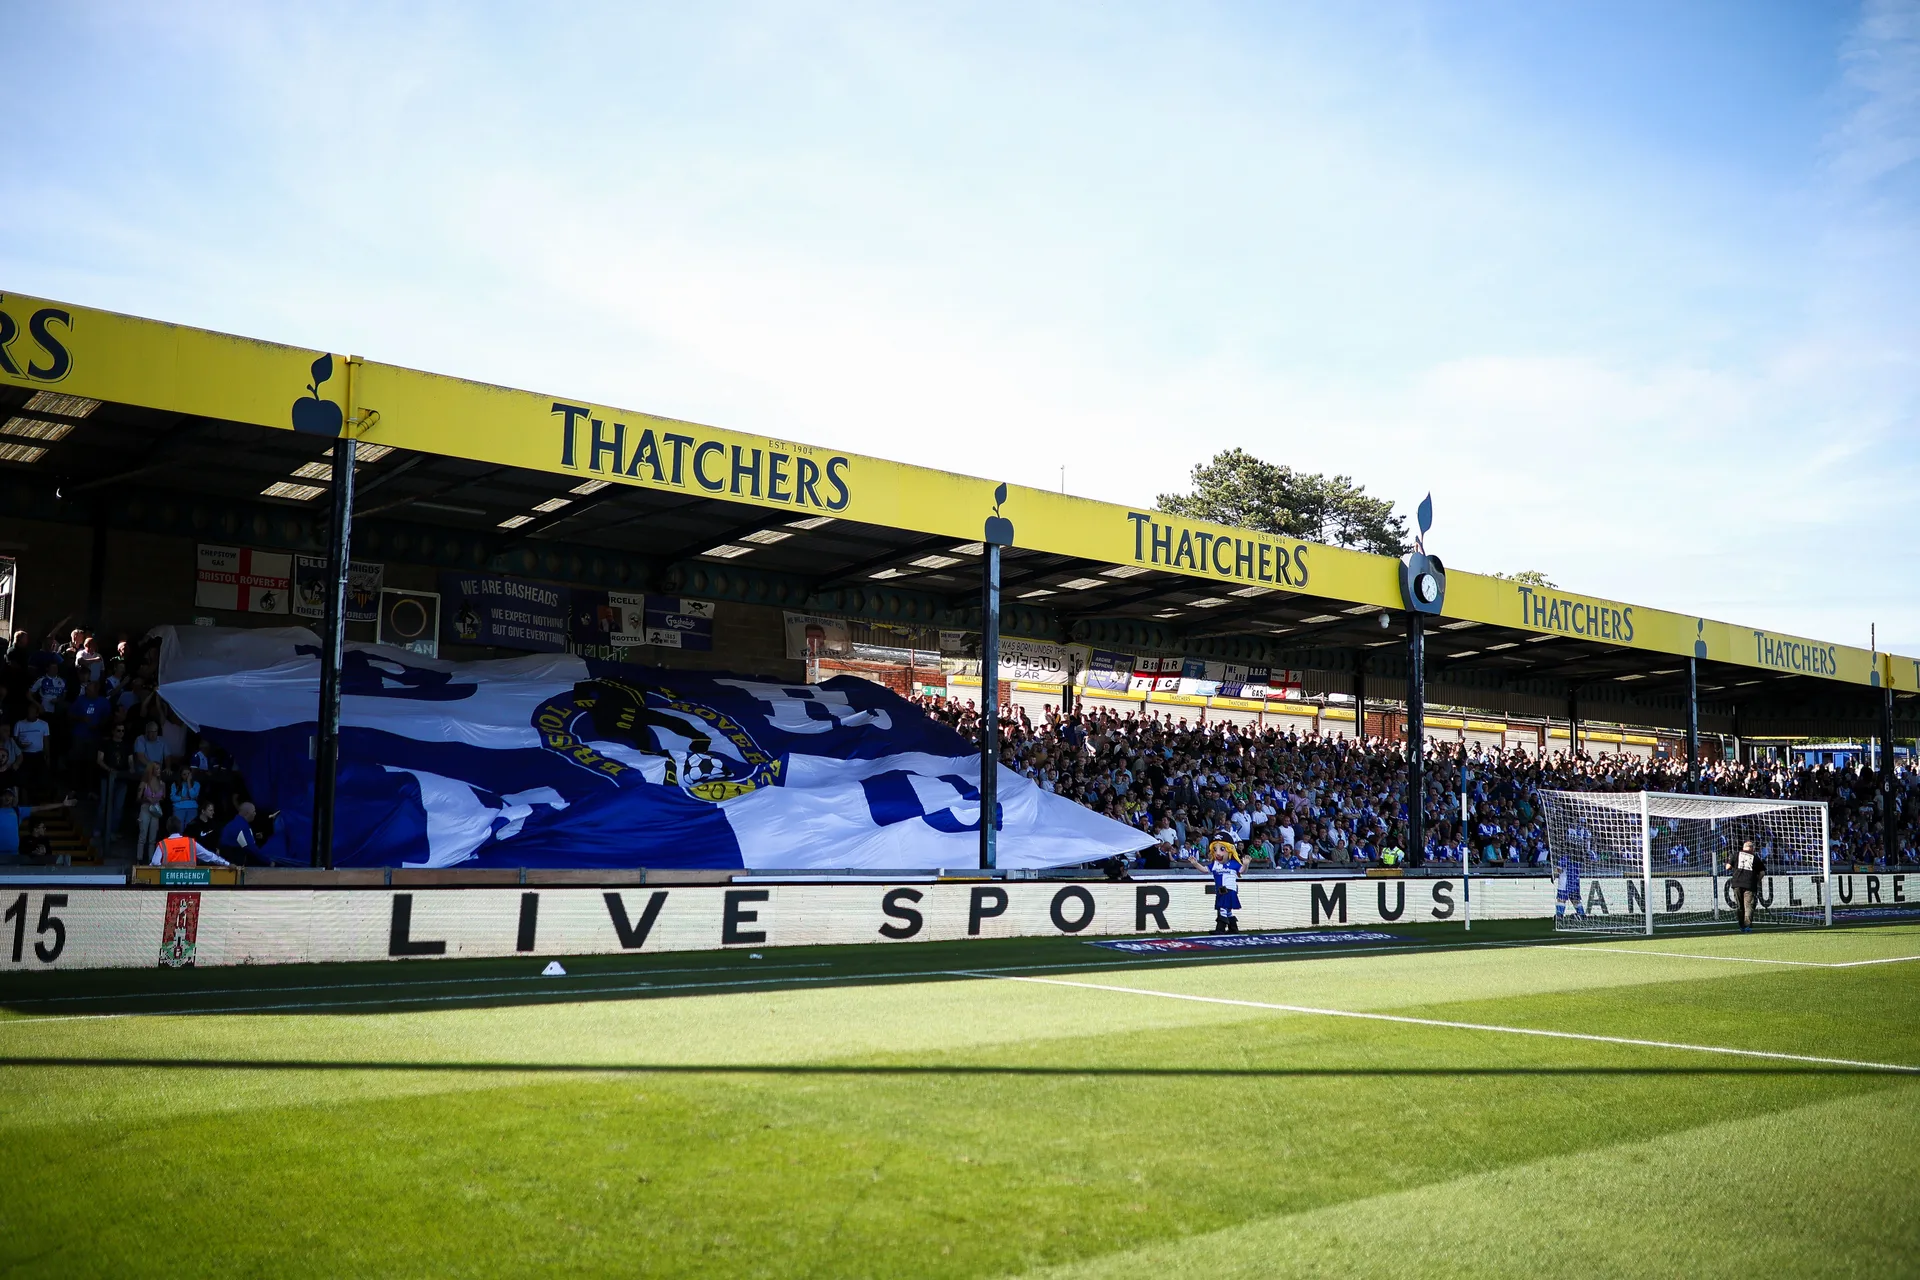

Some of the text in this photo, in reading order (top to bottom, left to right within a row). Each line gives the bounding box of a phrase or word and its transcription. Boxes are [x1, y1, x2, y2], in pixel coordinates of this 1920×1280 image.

[768, 439, 814, 458] EST. 1904
[551, 402, 851, 513] THATCHERS
[201, 549, 237, 560] CHEPSTOW
[1127, 511, 1310, 589] THATCHERS
[212, 559, 225, 568] GAS
[199, 571, 290, 590] BRISTOL ROVERS FC
[461, 579, 558, 608] WE ARE GASHEADS
[491, 607, 564, 629] WE EXPECT NOTHING
[1517, 586, 1634, 643] THATCHERS
[492, 623, 507, 636] BUT
[508, 625, 525, 639] GIVE
[1001, 640, 1066, 656] WAS BORN UNDER THE
[1753, 631, 1837, 676] THATCHERS
[1029, 655, 1061, 673] END
[1015, 670, 1040, 680] BAR
[931, 687, 946, 696] EXIT
[1169, 694, 1191, 702] THATCHERS
[1228, 699, 1249, 707] THATCHERS
[1284, 704, 1304, 712] THATCHERS
[1689, 770, 1696, 783] 5
[1884, 781, 1890, 793] 6
[165, 872, 205, 880] EMERGENCY
[388, 890, 770, 957] LIVE
[878, 884, 1239, 941] SPOR
[1585, 879, 1684, 915] AND
[5, 892, 69, 963] 15
